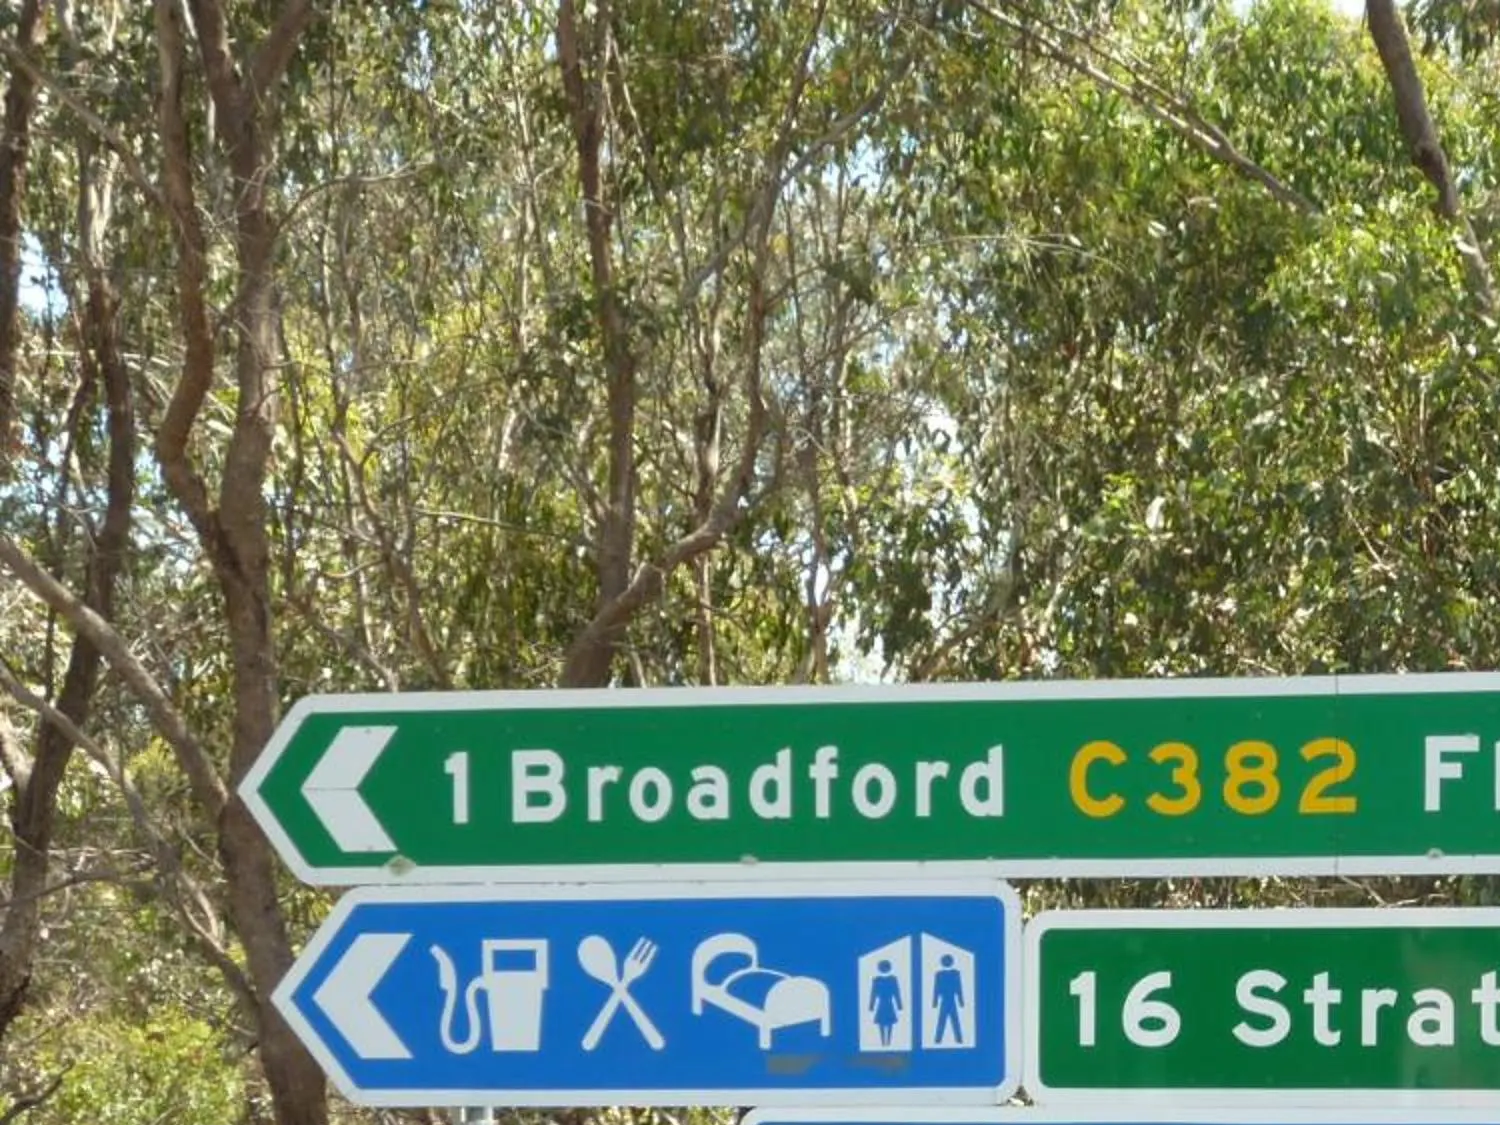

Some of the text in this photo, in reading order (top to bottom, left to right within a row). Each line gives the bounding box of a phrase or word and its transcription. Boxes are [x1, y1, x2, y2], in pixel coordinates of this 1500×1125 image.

[446, 752, 468, 823] 1
[512, 746, 1003, 822] Broadford
[1070, 738, 1356, 816] C382
[1070, 972, 1180, 1046] 16
